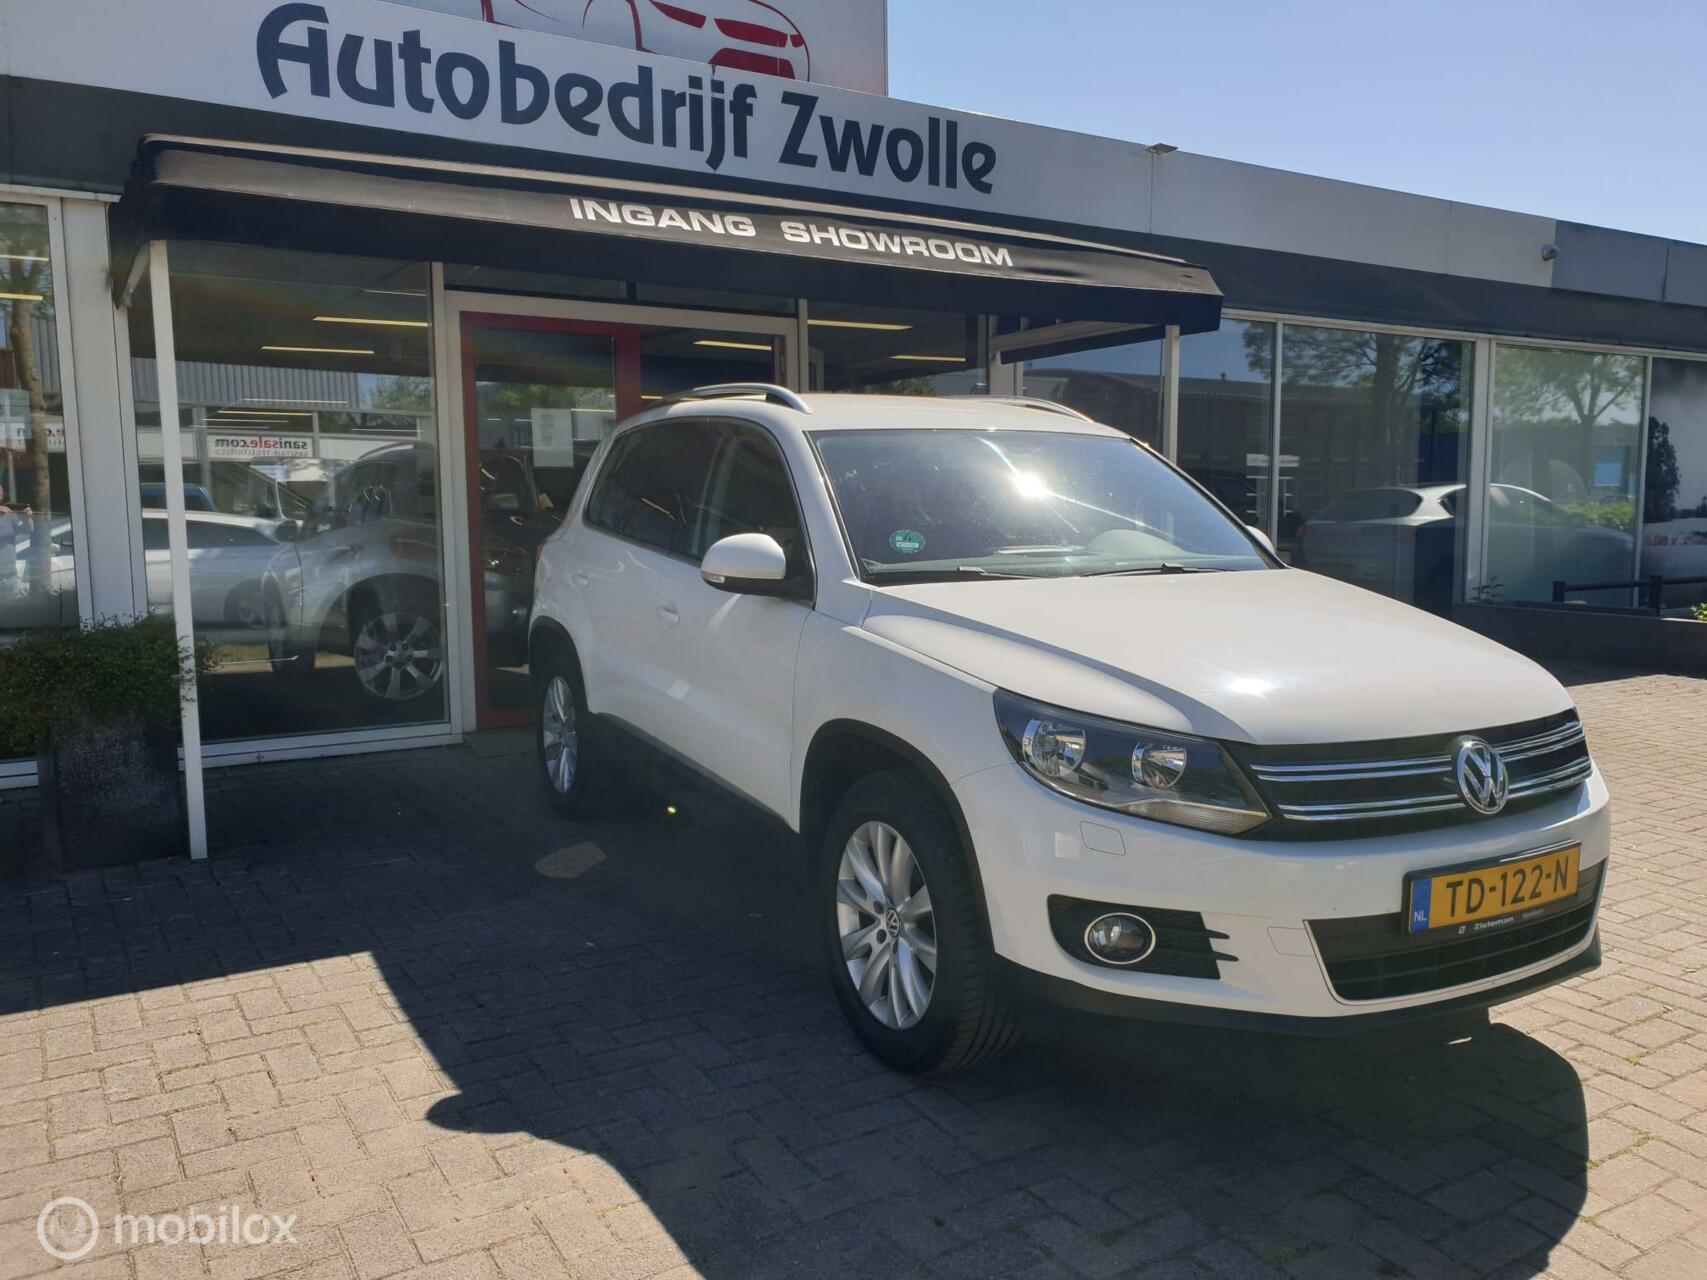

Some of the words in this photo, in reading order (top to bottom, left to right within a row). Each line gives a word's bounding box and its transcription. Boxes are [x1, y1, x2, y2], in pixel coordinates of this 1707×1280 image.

[256, 2, 757, 171] Autobedrijf
[778, 90, 997, 195] Zwolle
[570, 198, 757, 238] INGANG
[781, 221, 1013, 267] SHOWROOM
[1413, 909, 1428, 923] NL
[1446, 856, 1569, 918] TD-122-N
